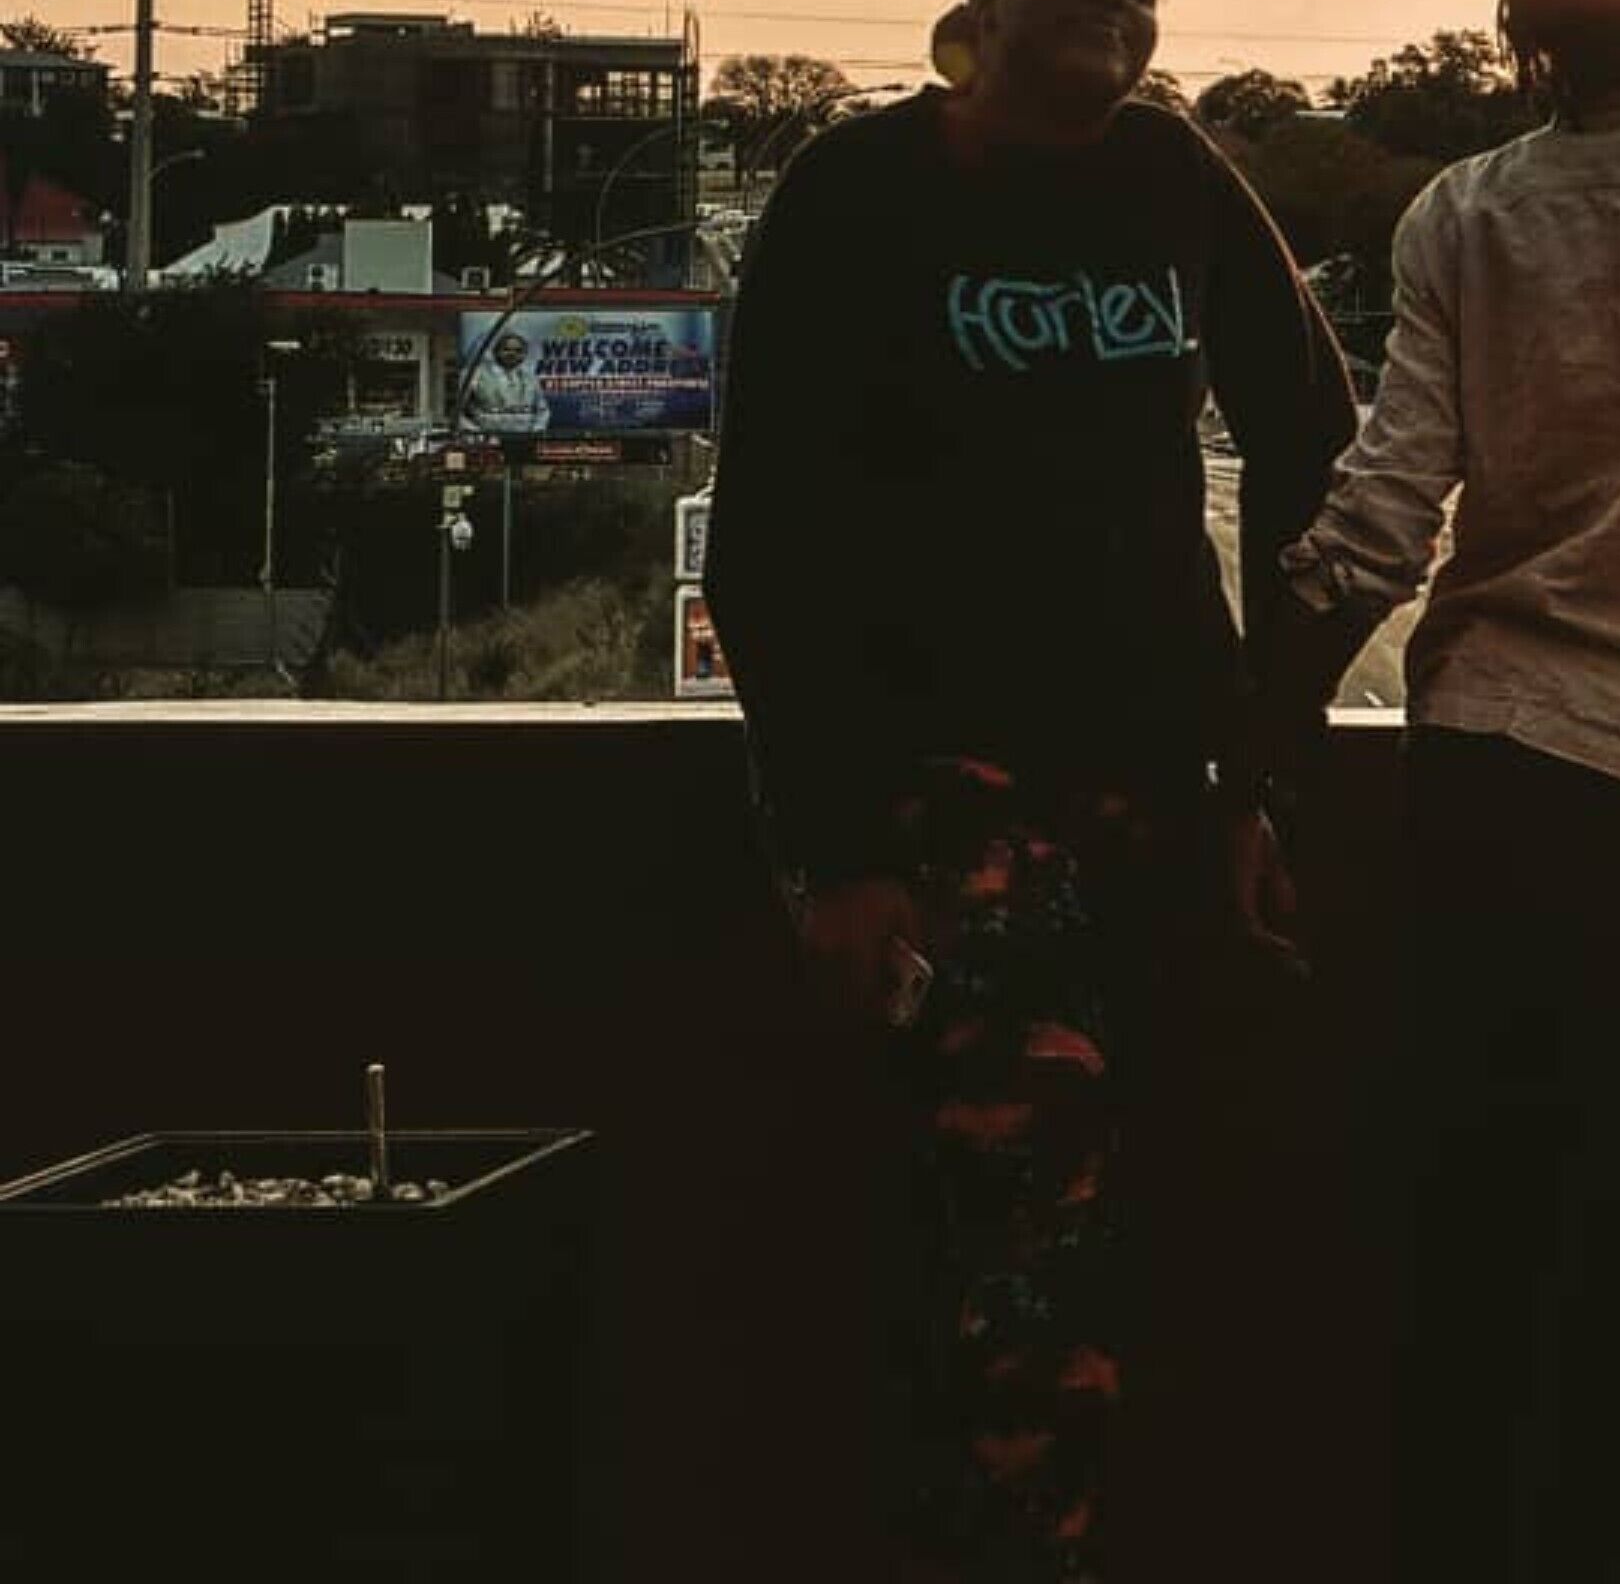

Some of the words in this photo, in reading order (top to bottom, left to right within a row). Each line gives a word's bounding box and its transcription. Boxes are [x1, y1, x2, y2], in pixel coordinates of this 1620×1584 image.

[947, 264, 1190, 370] Hurley
[543, 338, 667, 358] WELCOME
[536, 358, 594, 375] NEW
[598, 358, 706, 376] ADDRE
